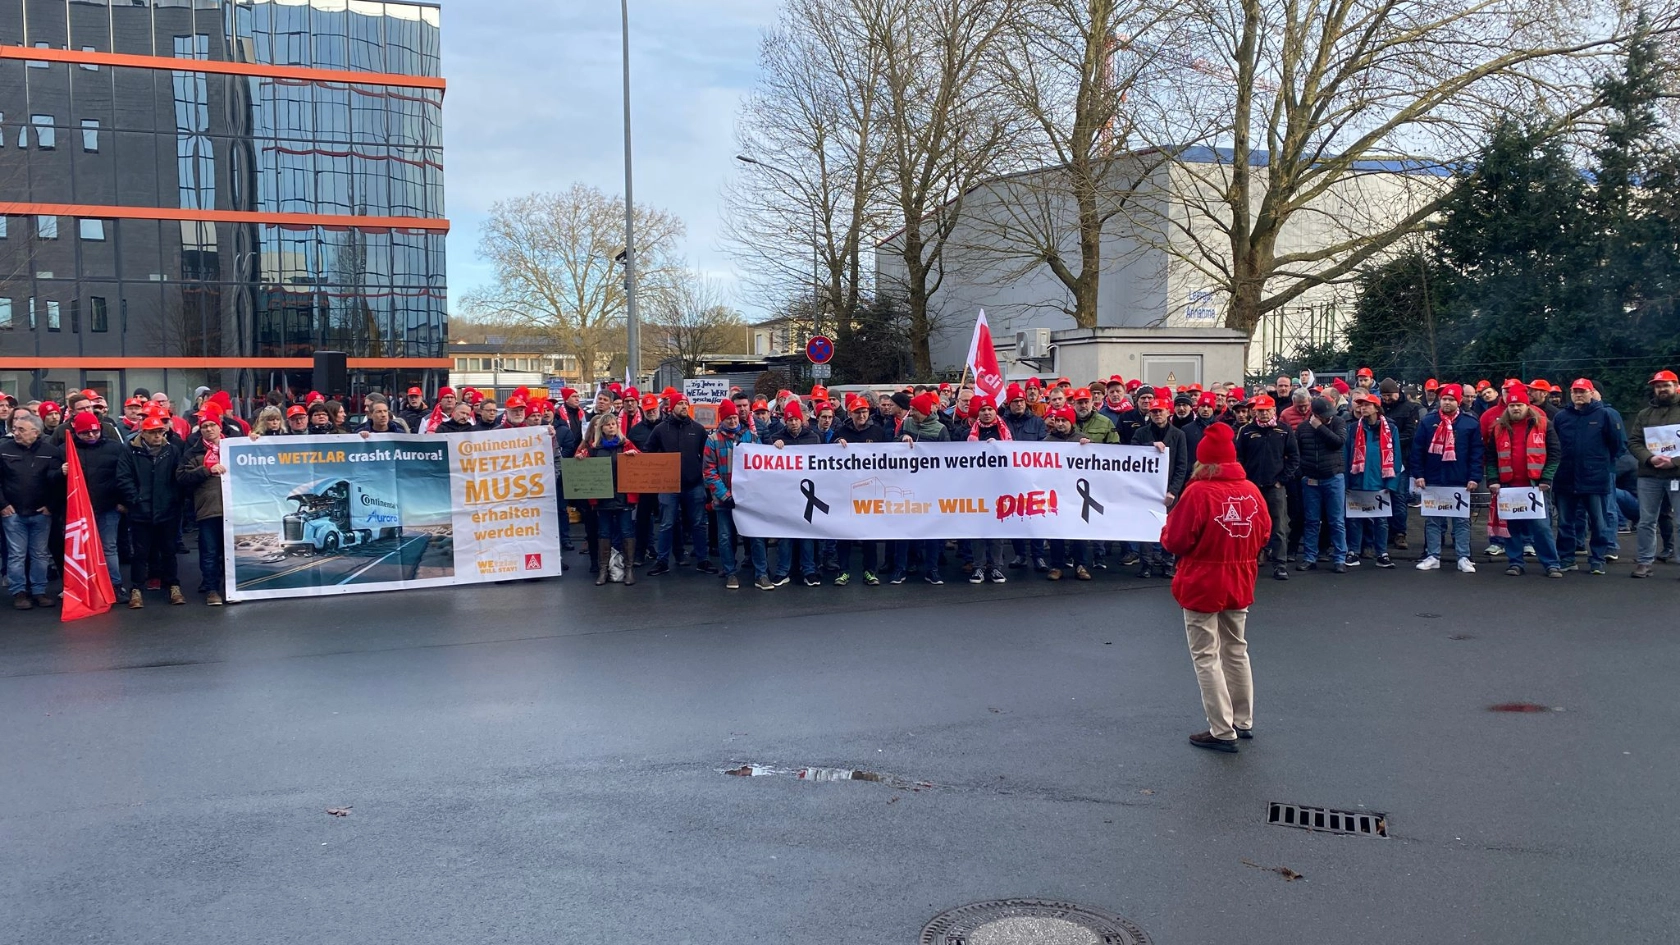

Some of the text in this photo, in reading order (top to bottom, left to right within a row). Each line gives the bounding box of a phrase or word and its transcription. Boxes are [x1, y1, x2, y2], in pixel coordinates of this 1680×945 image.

[457, 436, 533, 456] Continental
[236, 449, 443, 466] Ohne WETZLAR crasht Aurora!
[459, 451, 546, 473] WETZLAR
[743, 451, 1160, 473] LOKALE Entscheidungen werden LOKAL verhandelt!
[465, 473, 545, 503] MUSS
[853, 498, 989, 514] WEtzlar WILL
[996, 489, 1058, 521] DIE!
[1512, 505, 1528, 513] DIE!
[366, 509, 398, 523] Aurora
[471, 506, 541, 523] erhalten
[473, 522, 540, 541] werden!
[480, 567, 496, 575] WILL
